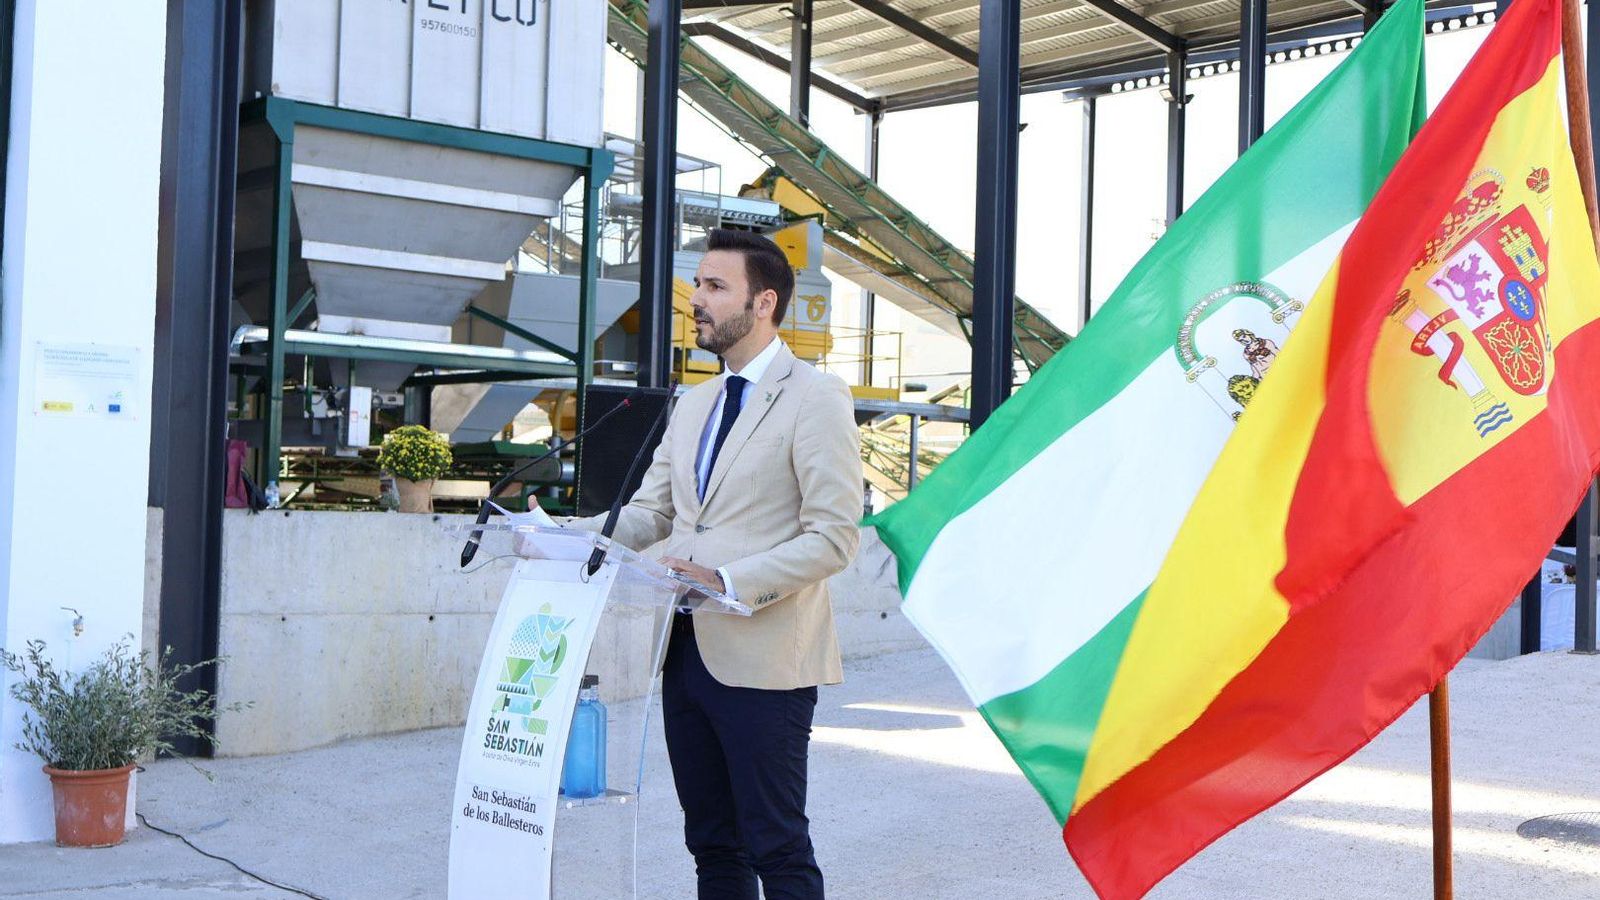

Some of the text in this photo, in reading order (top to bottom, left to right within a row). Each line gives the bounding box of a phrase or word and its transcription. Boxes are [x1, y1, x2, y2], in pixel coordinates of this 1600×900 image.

[420, 18, 477, 38] 957600150
[487, 717, 510, 734] SAN
[484, 733, 544, 758] SEBASTIÁN
[472, 785, 537, 814] San Sebastián
[463, 803, 544, 836] de los Ballesteros
